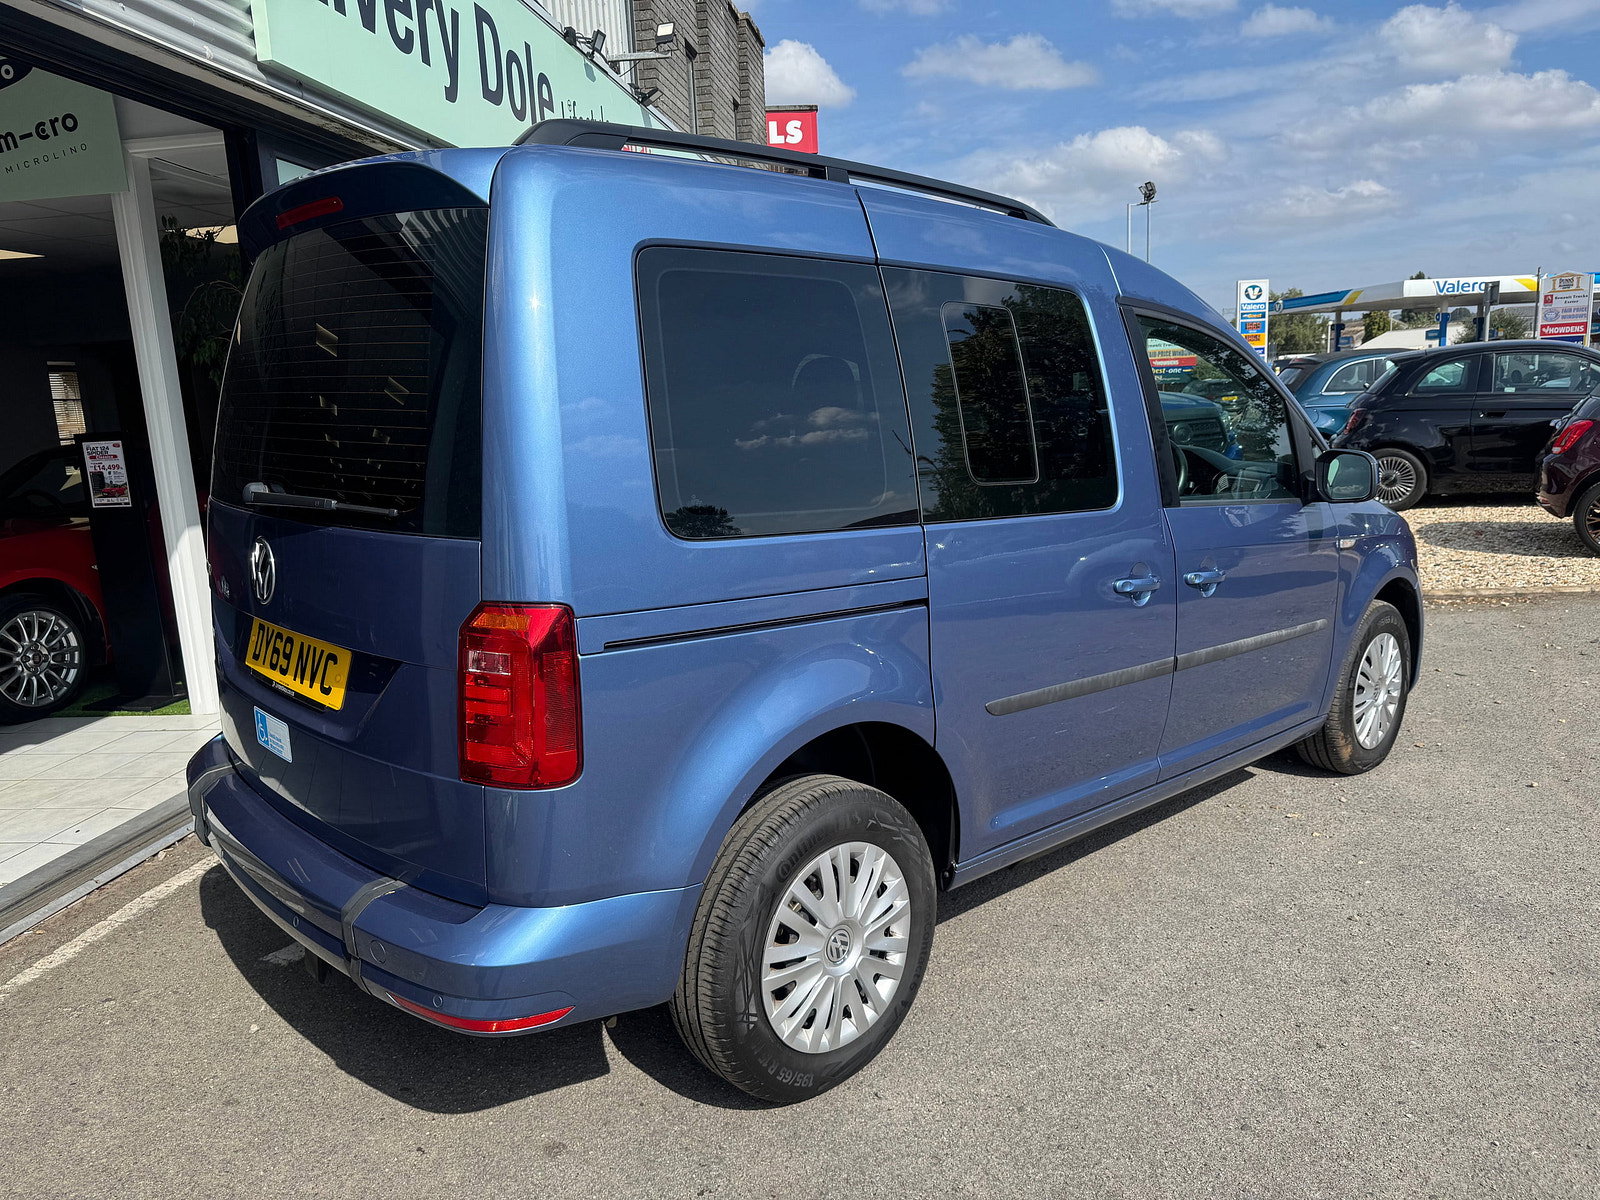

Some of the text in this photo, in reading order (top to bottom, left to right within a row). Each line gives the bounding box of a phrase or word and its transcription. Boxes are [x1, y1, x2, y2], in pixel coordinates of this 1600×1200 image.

[473, 2, 556, 123] Dole
[768, 120, 803, 144] LS
[5, 143, 88, 174] MICROLINO
[1549, 326, 1584, 334] HOWDENS
[252, 623, 338, 696] DY69 NVC
[776, 1066, 815, 1088] 195/65
